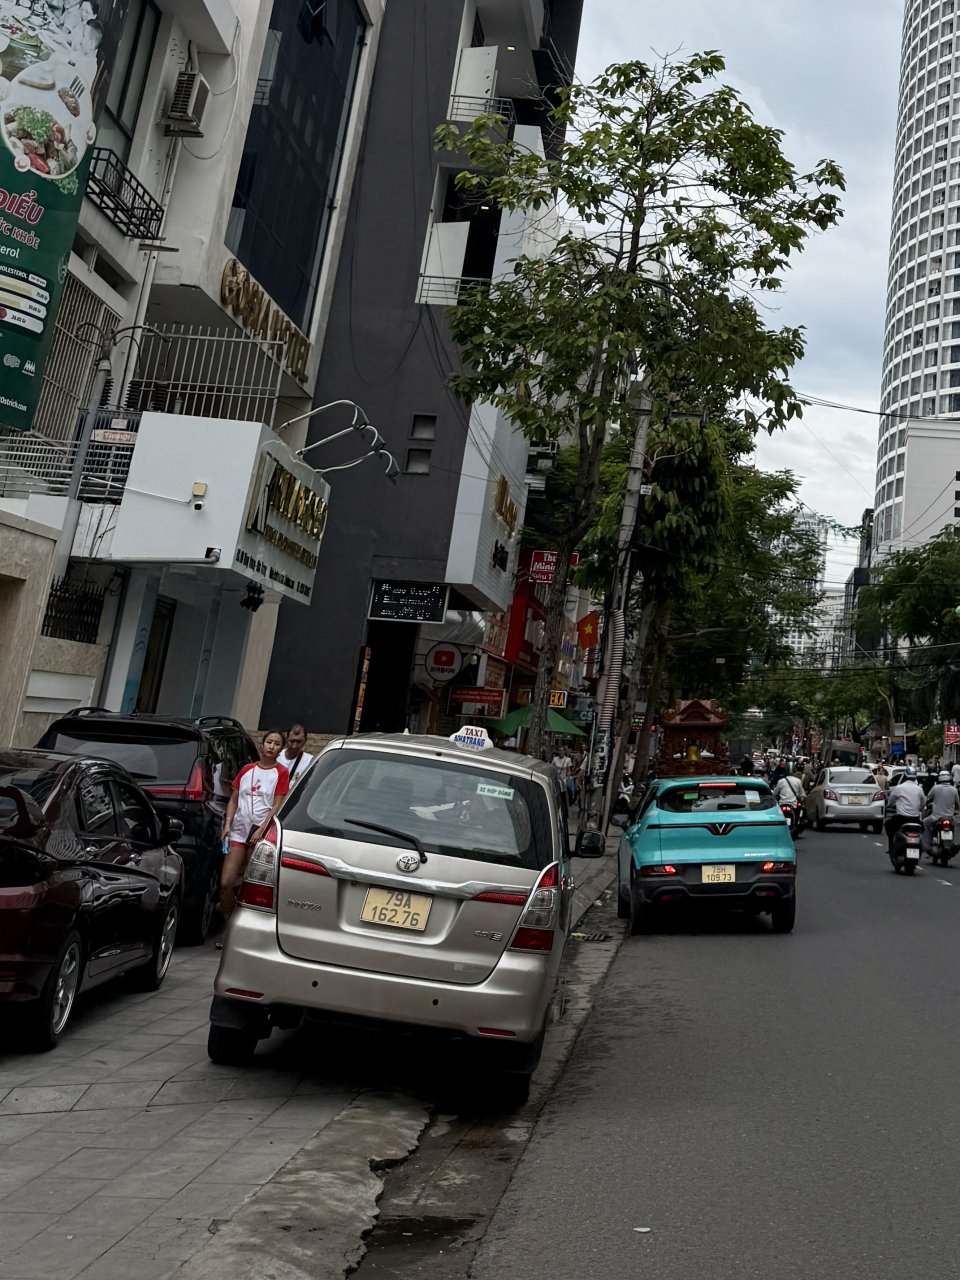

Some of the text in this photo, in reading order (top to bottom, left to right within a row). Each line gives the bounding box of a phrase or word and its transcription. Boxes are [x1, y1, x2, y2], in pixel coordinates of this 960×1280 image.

[11, 226, 41, 249] KHỎE
[0, 244, 20, 258] erol
[549, 692, 565, 706] EKA
[464, 726, 484, 737] TAXI
[706, 873, 732, 882] 109.73
[386, 890, 412, 909] 79A
[372, 906, 420, 927] 162.76
